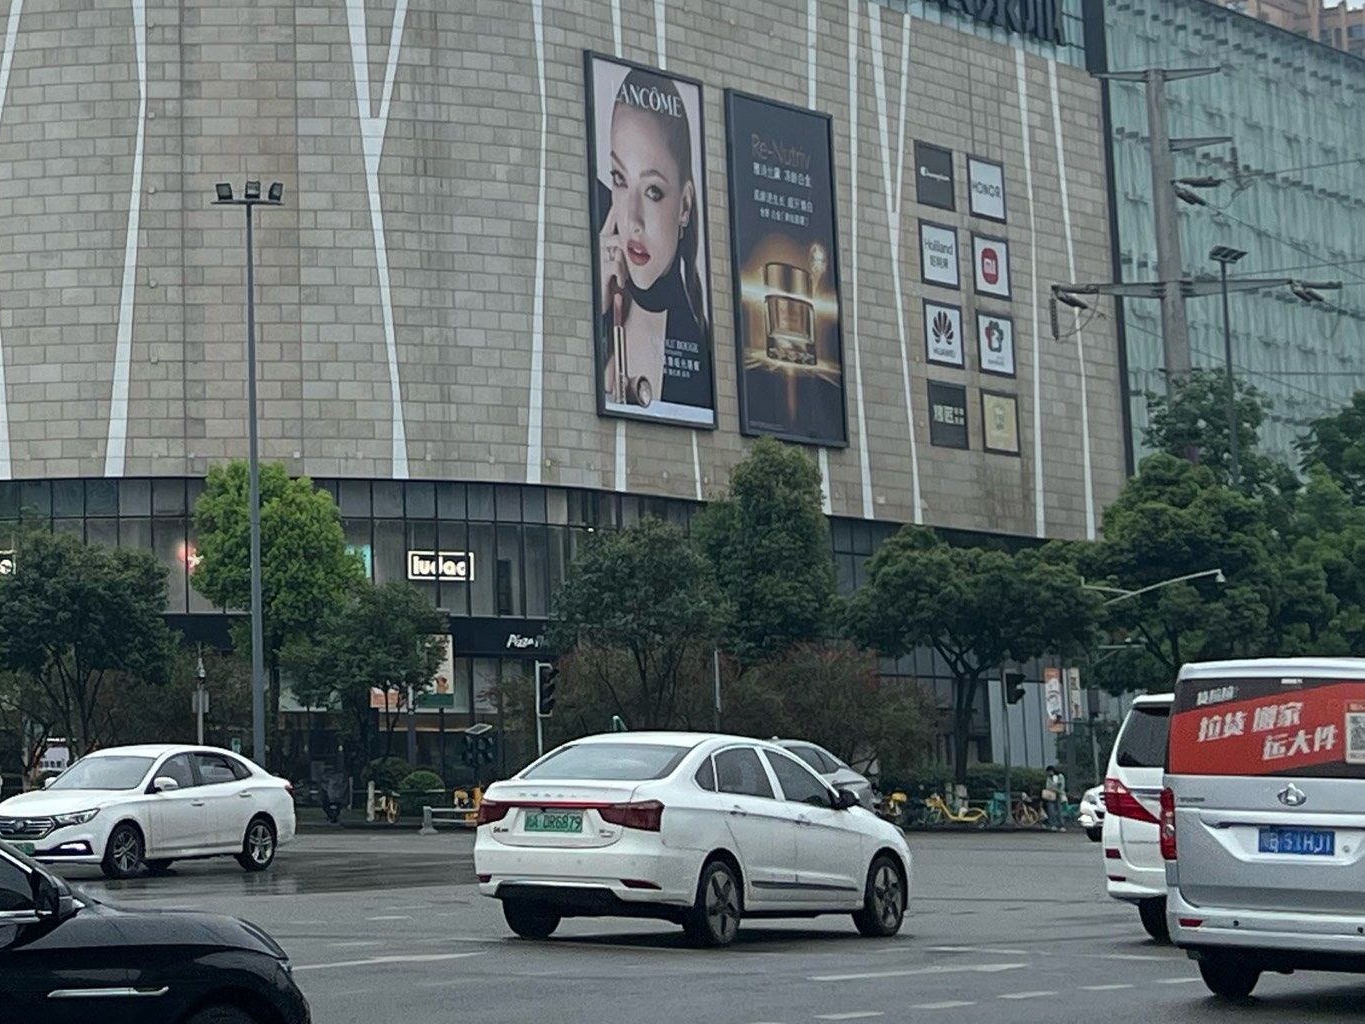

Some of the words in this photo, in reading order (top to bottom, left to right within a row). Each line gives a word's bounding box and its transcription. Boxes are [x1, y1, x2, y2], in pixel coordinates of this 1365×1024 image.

[506, 633, 534, 649] Pizza
[1197, 710, 1247, 743] 拉货
[1251, 701, 1304, 732] 搬家
[1261, 724, 1338, 761] 运大件
